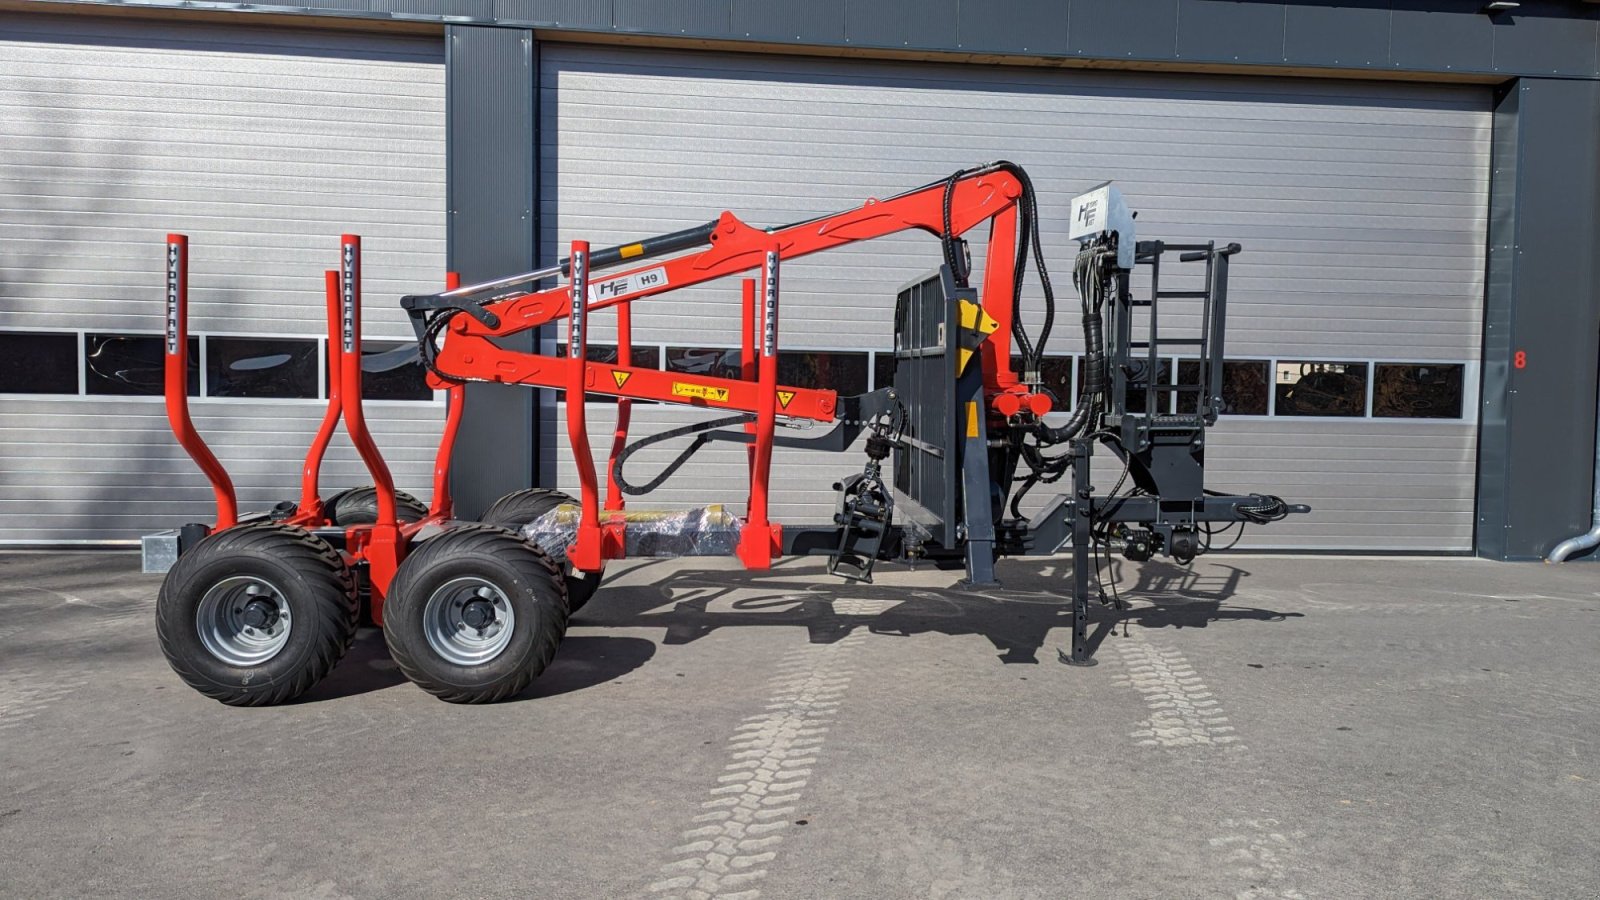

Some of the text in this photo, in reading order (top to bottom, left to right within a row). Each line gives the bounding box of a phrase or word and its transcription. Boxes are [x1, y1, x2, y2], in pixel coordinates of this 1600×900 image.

[167, 247, 177, 351] HYDROFAST
[343, 247, 353, 350] HYDROFAST
[571, 254, 583, 355] HYDROFAST
[641, 273, 658, 285] H9
[764, 254, 776, 354] HYDROFAST
[1514, 351, 1526, 369] 8
